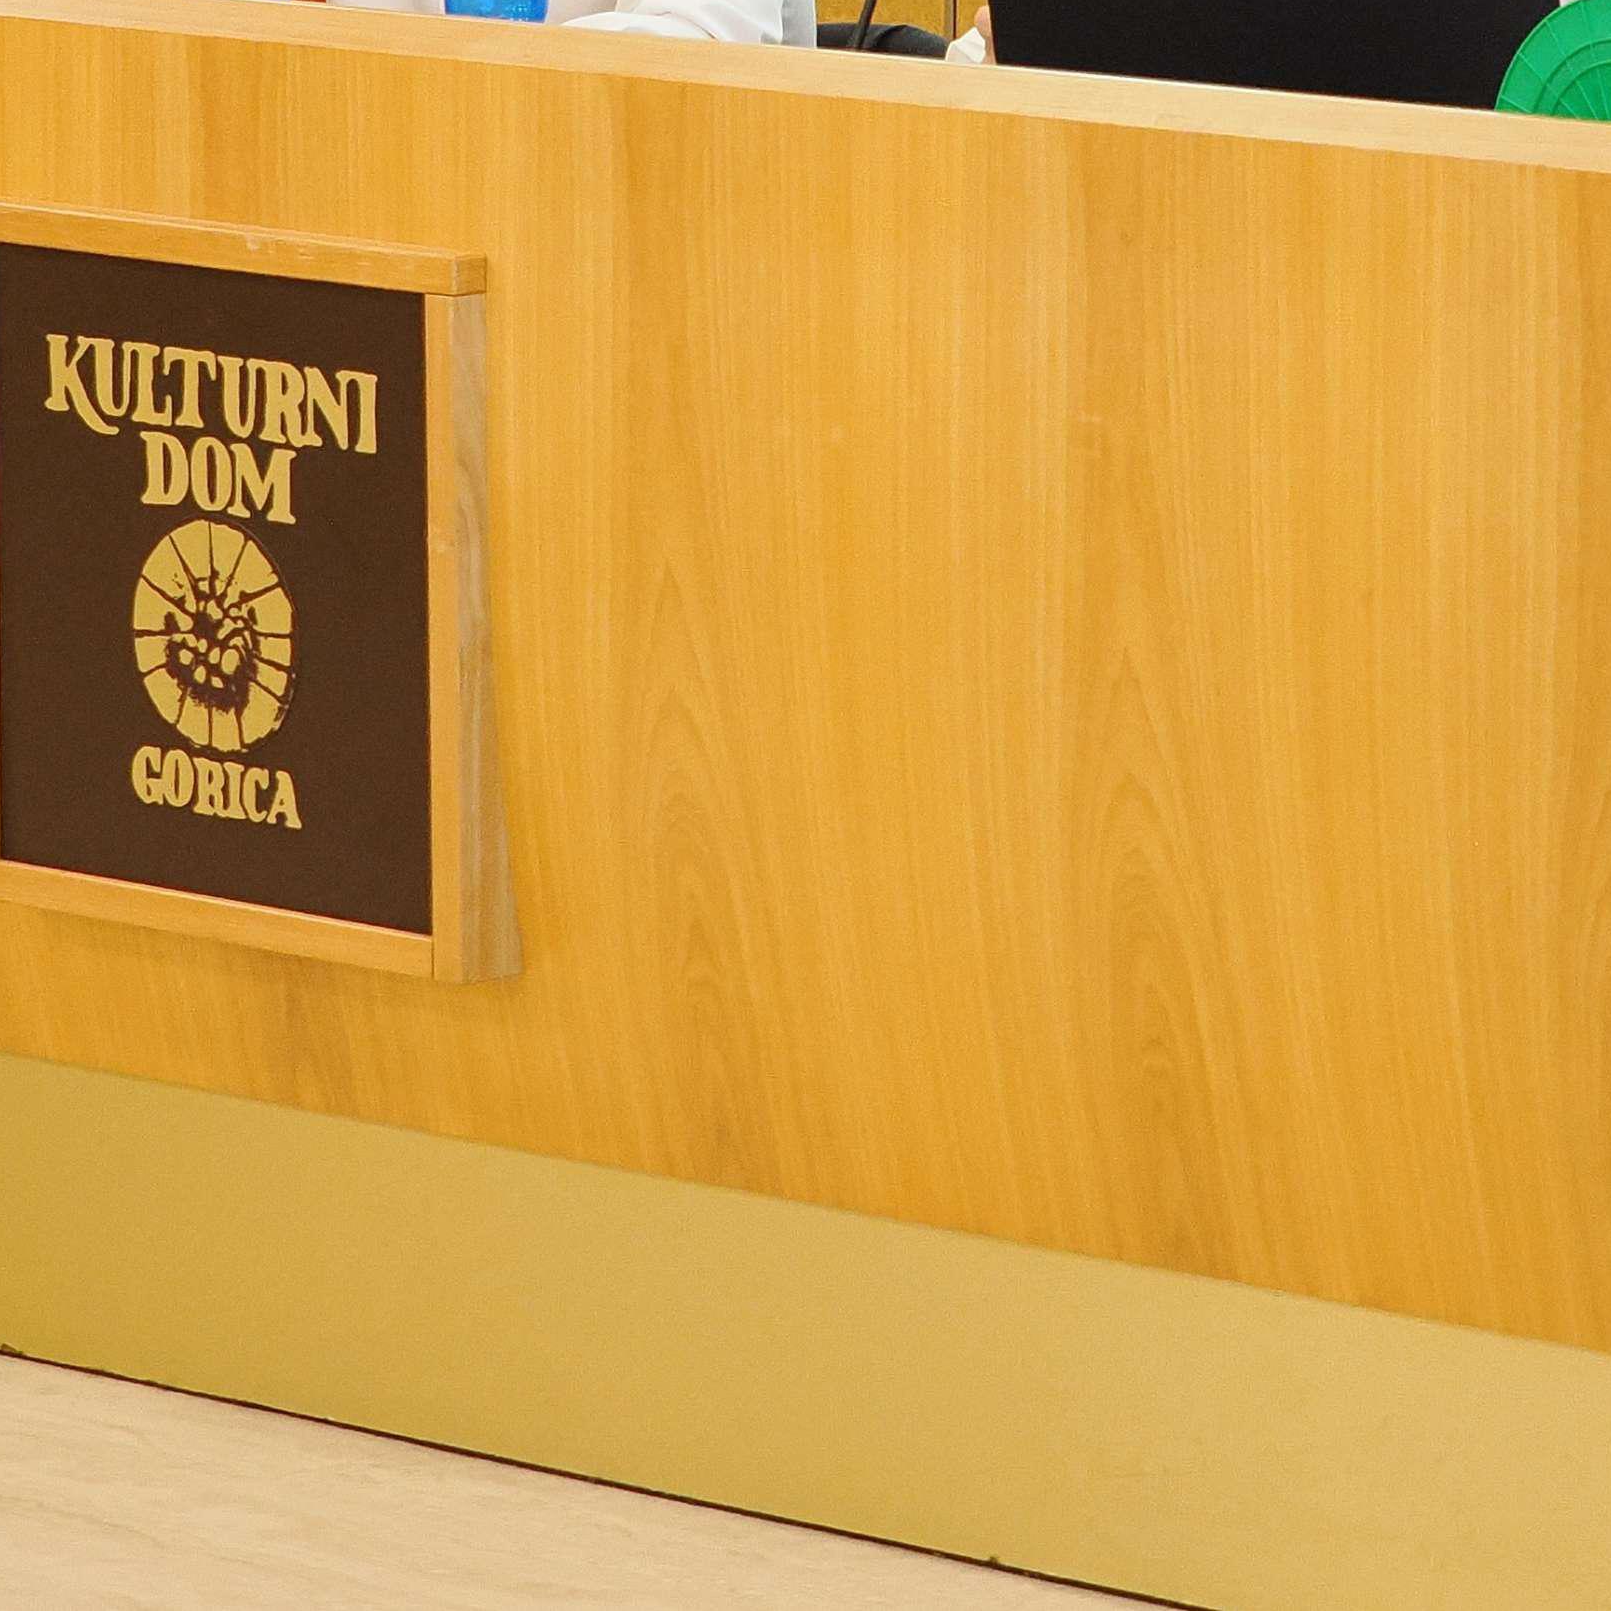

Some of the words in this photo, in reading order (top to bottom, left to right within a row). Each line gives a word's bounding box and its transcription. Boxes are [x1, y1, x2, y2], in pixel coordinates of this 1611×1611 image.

[44, 333, 379, 455] KULTURNI
[140, 430, 297, 525] DOM
[131, 745, 303, 830] GORICA
